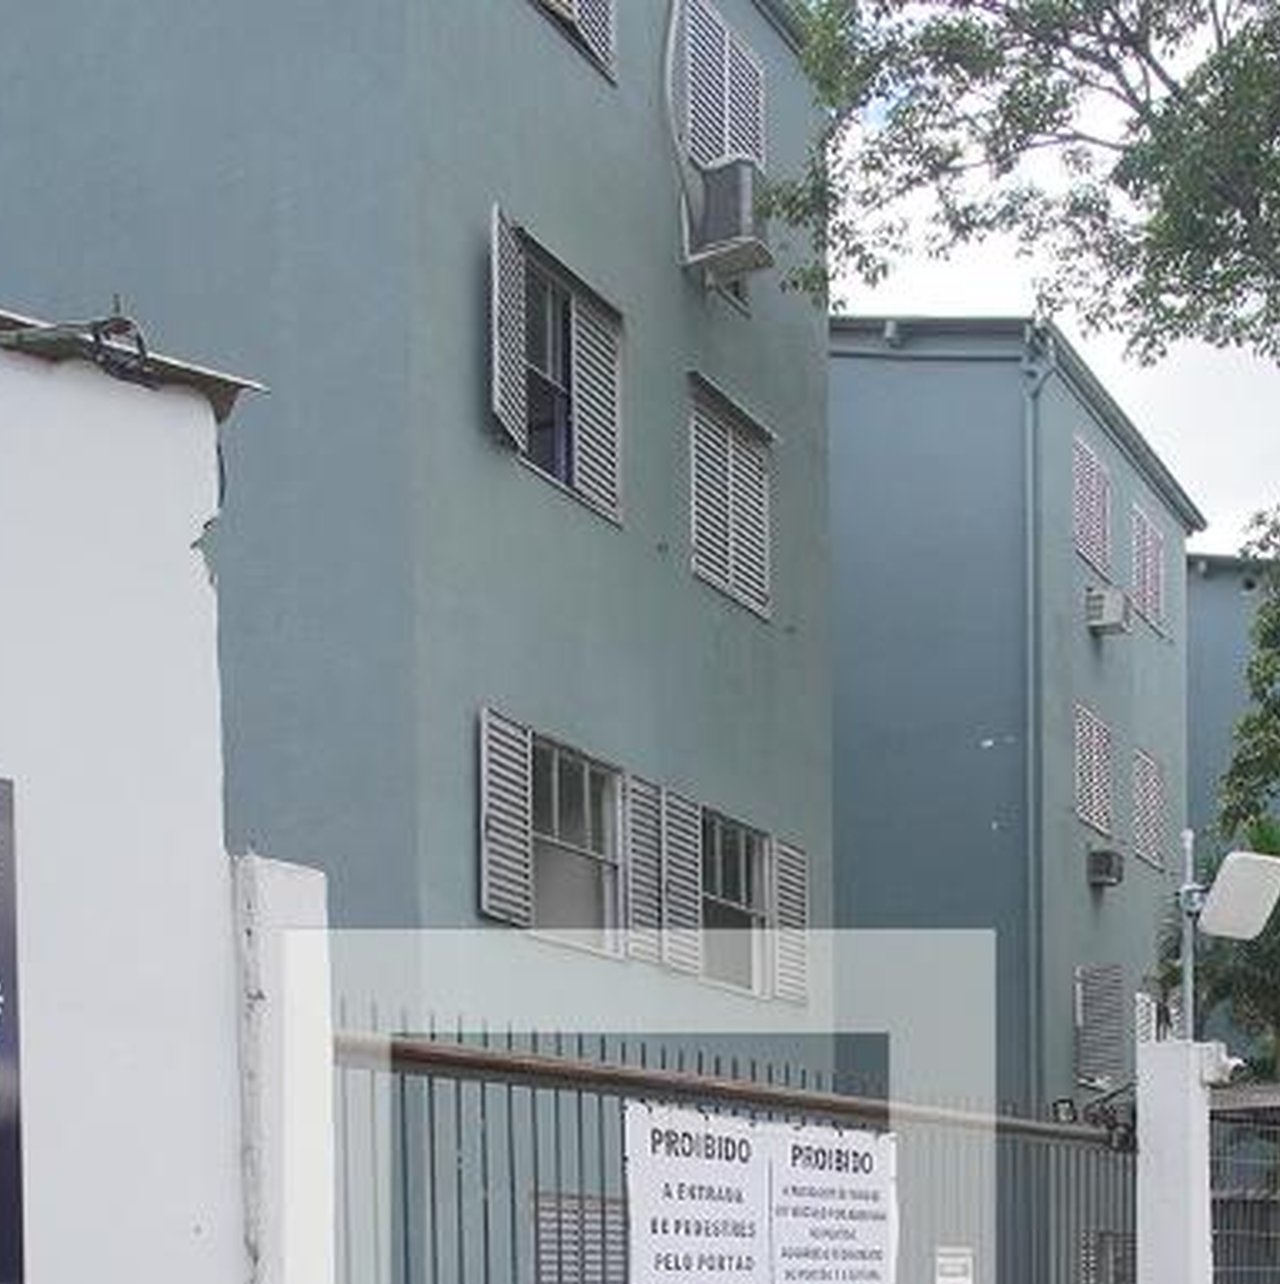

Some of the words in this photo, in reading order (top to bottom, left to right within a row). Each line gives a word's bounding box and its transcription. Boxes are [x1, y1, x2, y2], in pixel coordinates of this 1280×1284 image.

[650, 1127, 753, 1165] PROIBIDO
[790, 1143, 874, 1175] PROIBIDO
[653, 1252, 693, 1272] PELO
